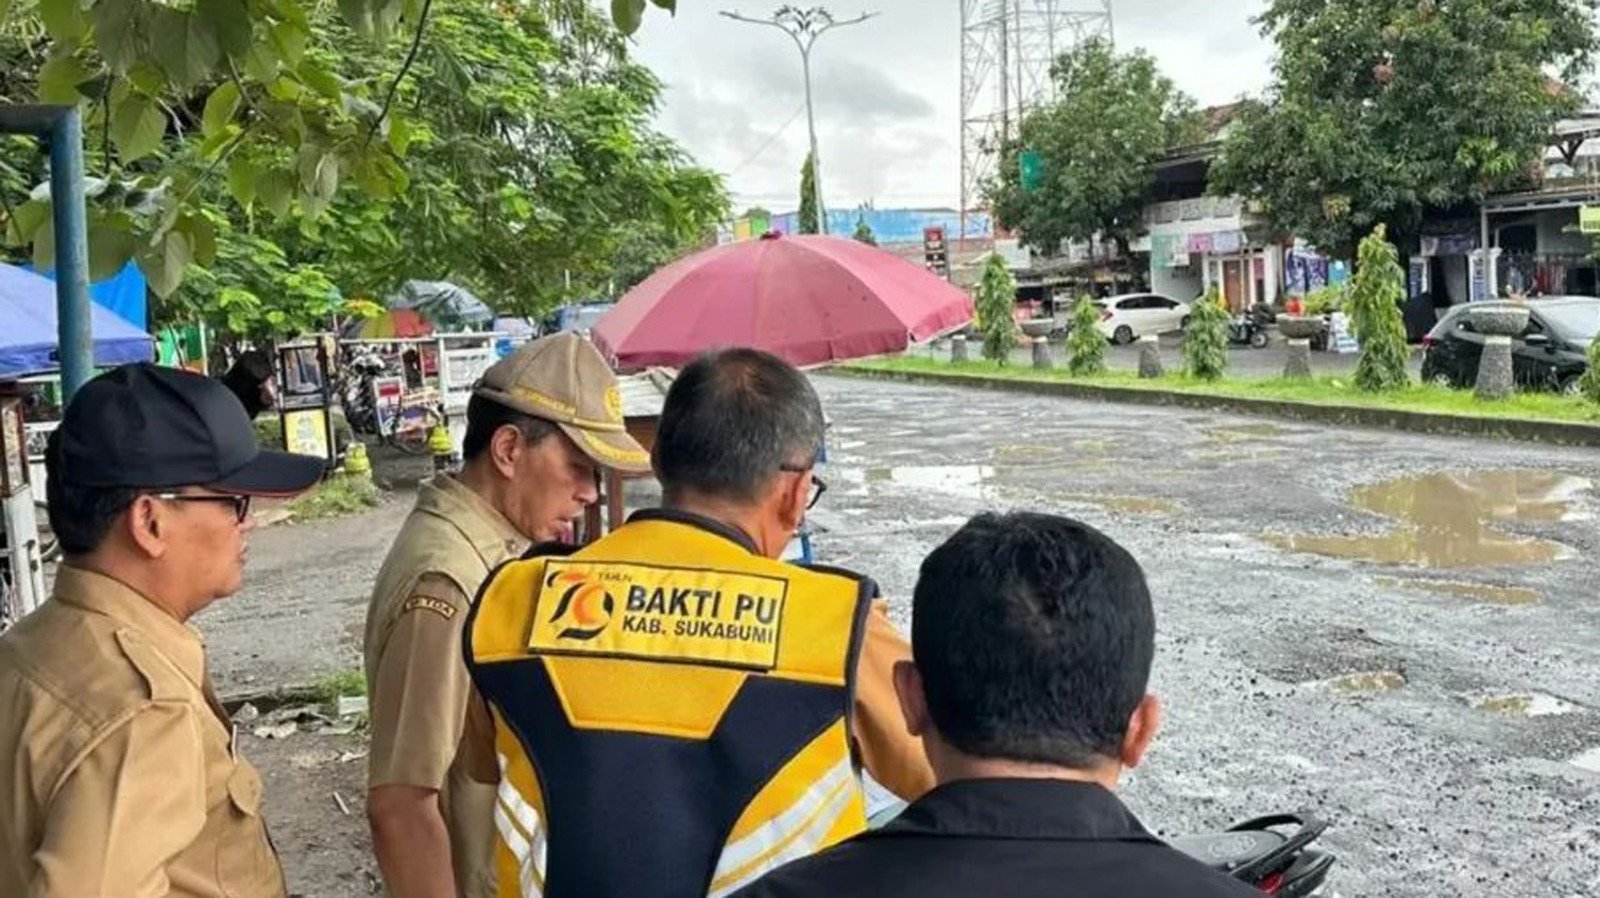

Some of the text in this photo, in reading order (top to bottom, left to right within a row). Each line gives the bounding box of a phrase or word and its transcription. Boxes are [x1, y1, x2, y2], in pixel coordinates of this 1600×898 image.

[625, 585, 777, 624] BAKTI PU
[622, 615, 773, 644] KAB. SUKABUMI
